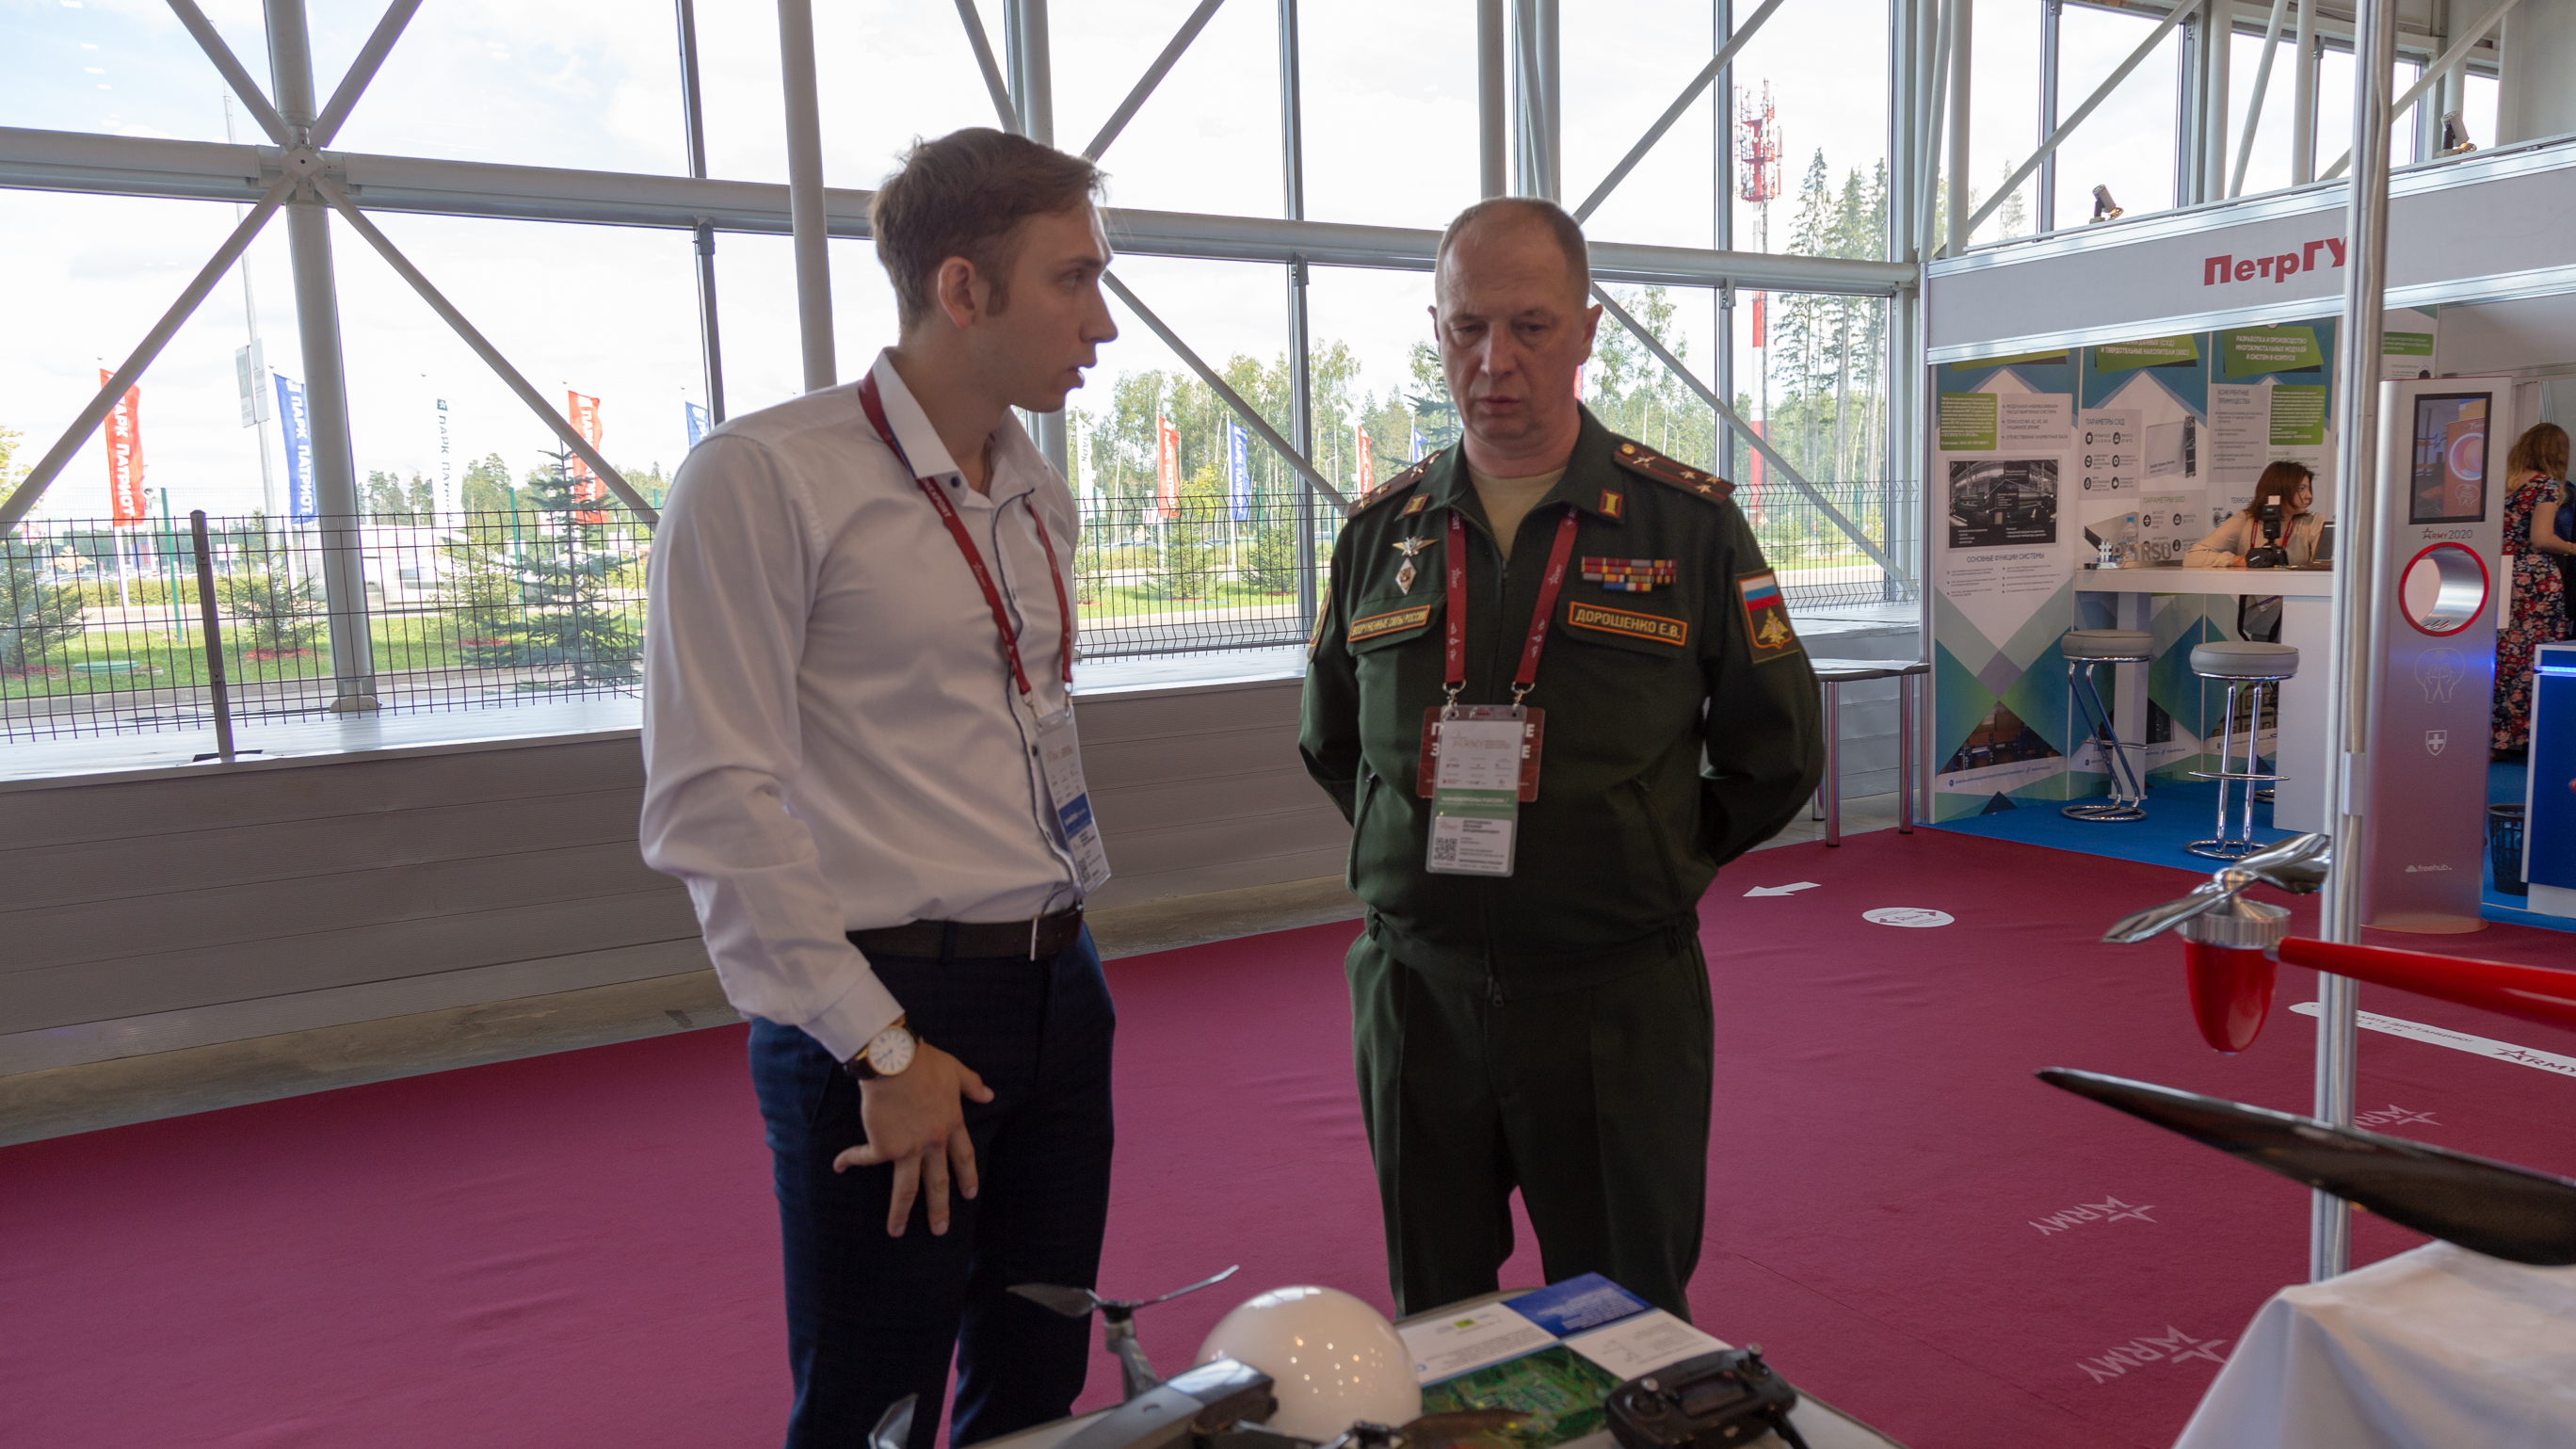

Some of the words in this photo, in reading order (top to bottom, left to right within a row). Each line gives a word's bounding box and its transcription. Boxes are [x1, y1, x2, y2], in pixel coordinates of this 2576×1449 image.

[2204, 236, 2346, 286] ПетрГУ
[2143, 347, 2175, 356] НАКОПИТЕЛИ
[2284, 345, 2307, 353] МОДУЛЕЙ
[114, 395, 129, 438] АРК
[290, 395, 308, 439] ПАРК
[438, 414, 450, 455] ПАРК
[1164, 431, 1173, 461] ПАРК
[116, 443, 136, 516] ПАТРИОТ
[298, 444, 314, 515] ПАТРИОТ
[1967, 555, 1994, 563] ОСНОВНЫЕ
[1994, 554, 2019, 562] ФУНКЦИИ
[1575, 608, 1657, 634] ДОРОШЕНКО
[1658, 622, 1681, 639] Е.В.
[2387, 1022, 2473, 1043] ДИСТАНЦИЮ!
[2492, 1049, 2576, 1074] ARMY
[2027, 1194, 2159, 1236] ARMY
[2076, 1324, 2229, 1384] ARMY
